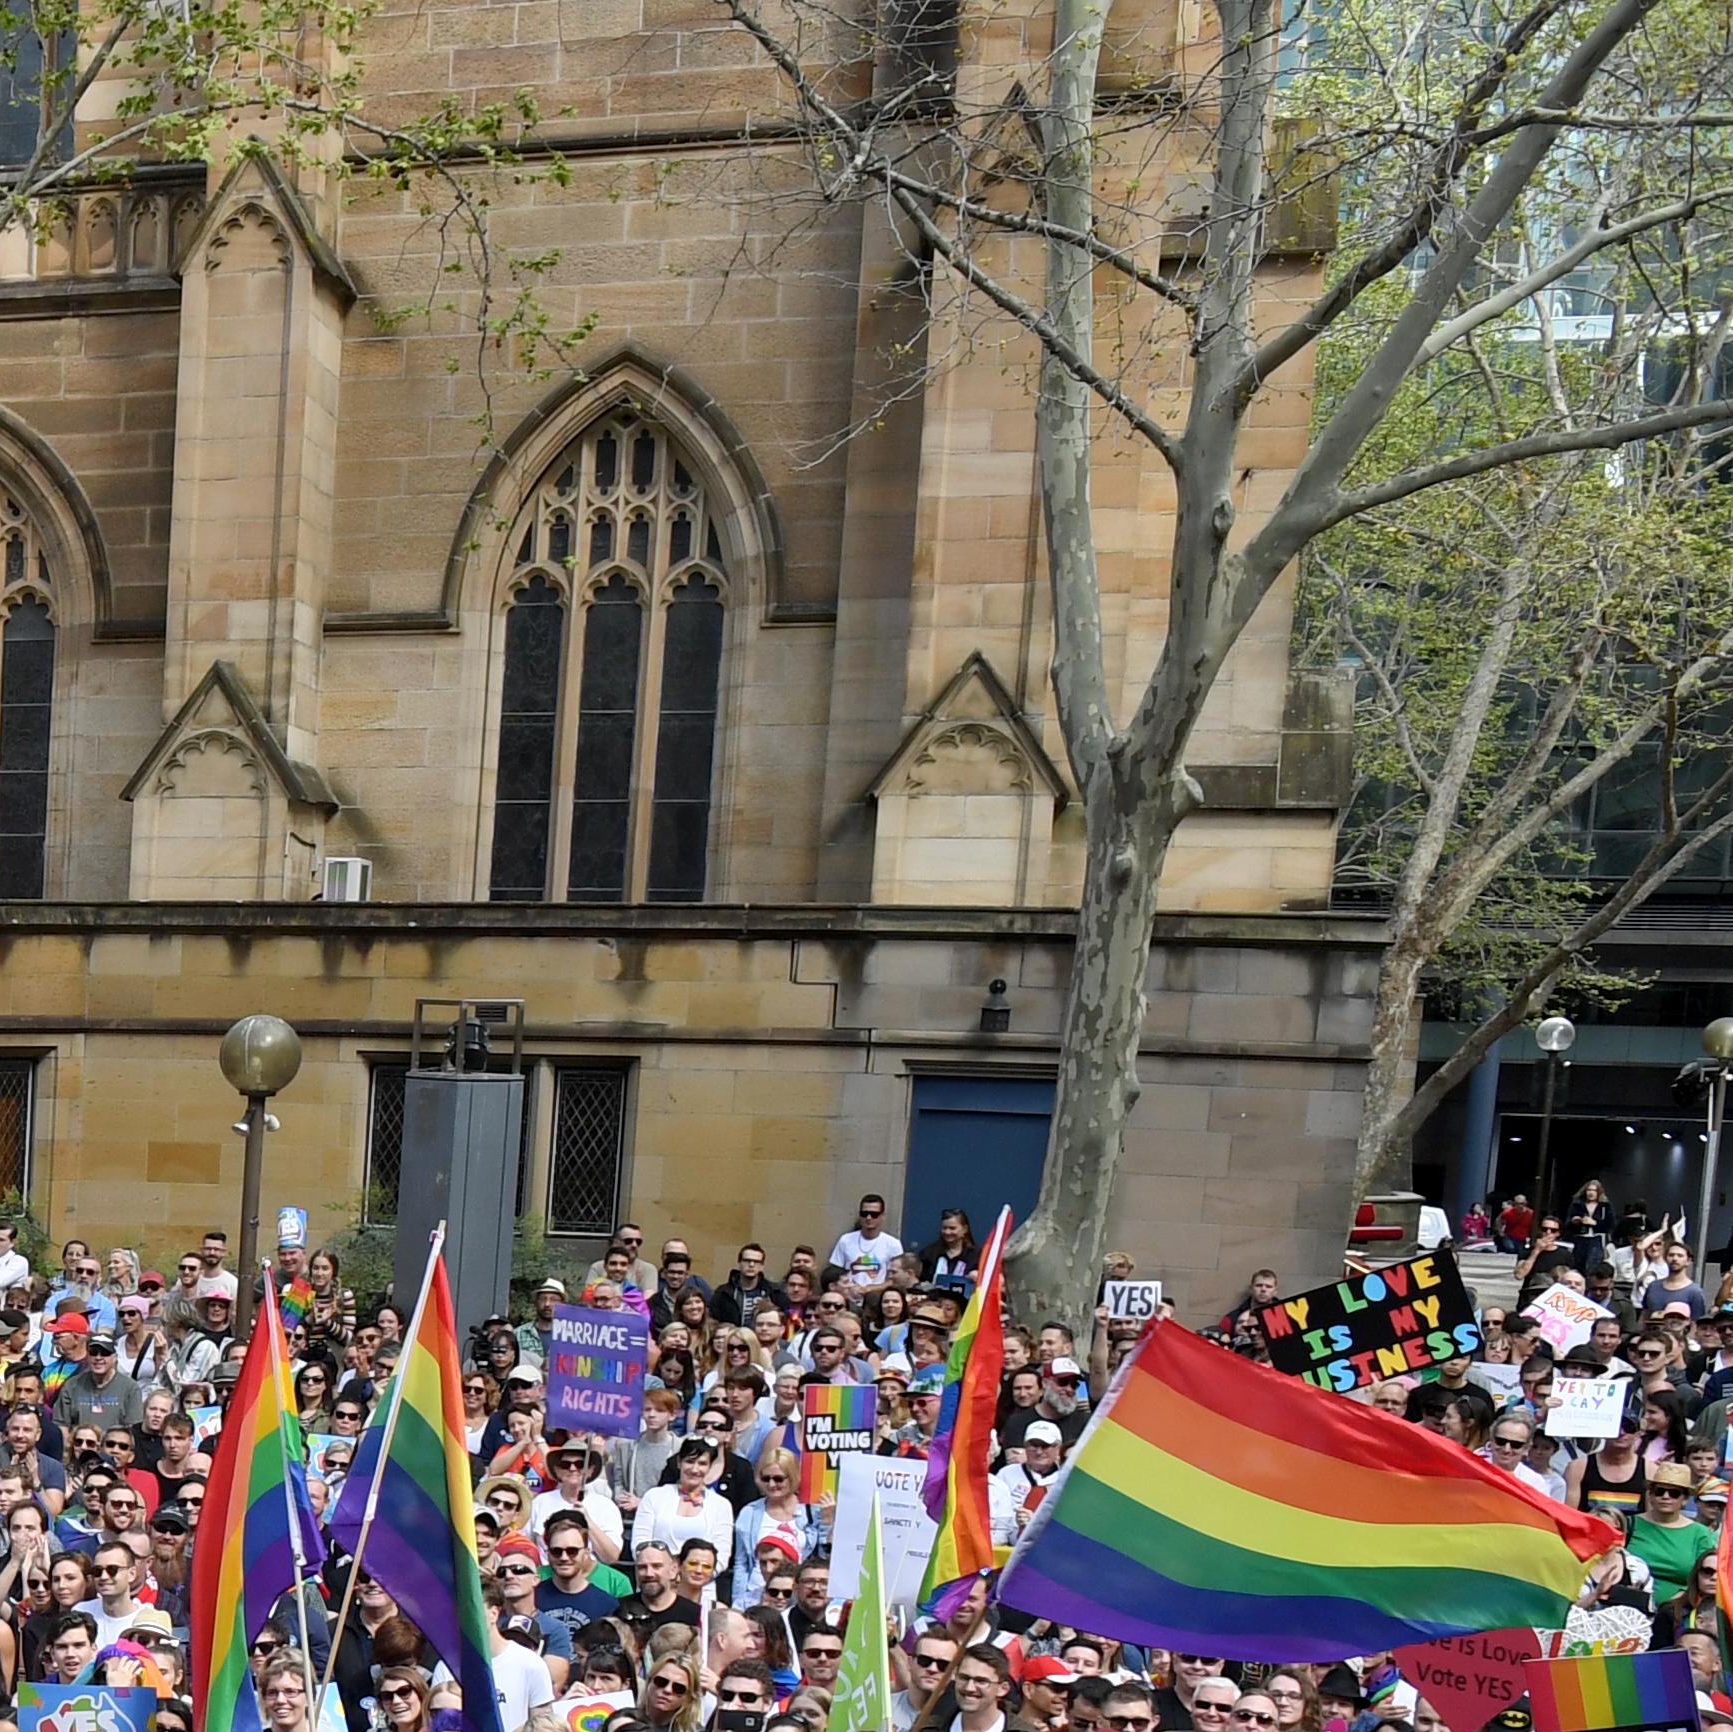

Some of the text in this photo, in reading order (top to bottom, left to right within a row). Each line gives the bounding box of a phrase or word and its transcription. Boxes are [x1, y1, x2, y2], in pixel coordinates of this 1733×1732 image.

[1262, 1257, 1442, 1339] MY LOVE
[1303, 1296, 1441, 1361] IS MY
[556, 1353, 642, 1386] KINSHIP
[1301, 1323, 1481, 1393] USINESS
[561, 1385, 632, 1419] RIGHTS
[806, 1416, 833, 1433] I'M
[806, 1431, 872, 1451] VOTING
[875, 1469, 910, 1490] VOTE
[1458, 1637, 1477, 1655] is
[1415, 1660, 1514, 1702] Vote YES
